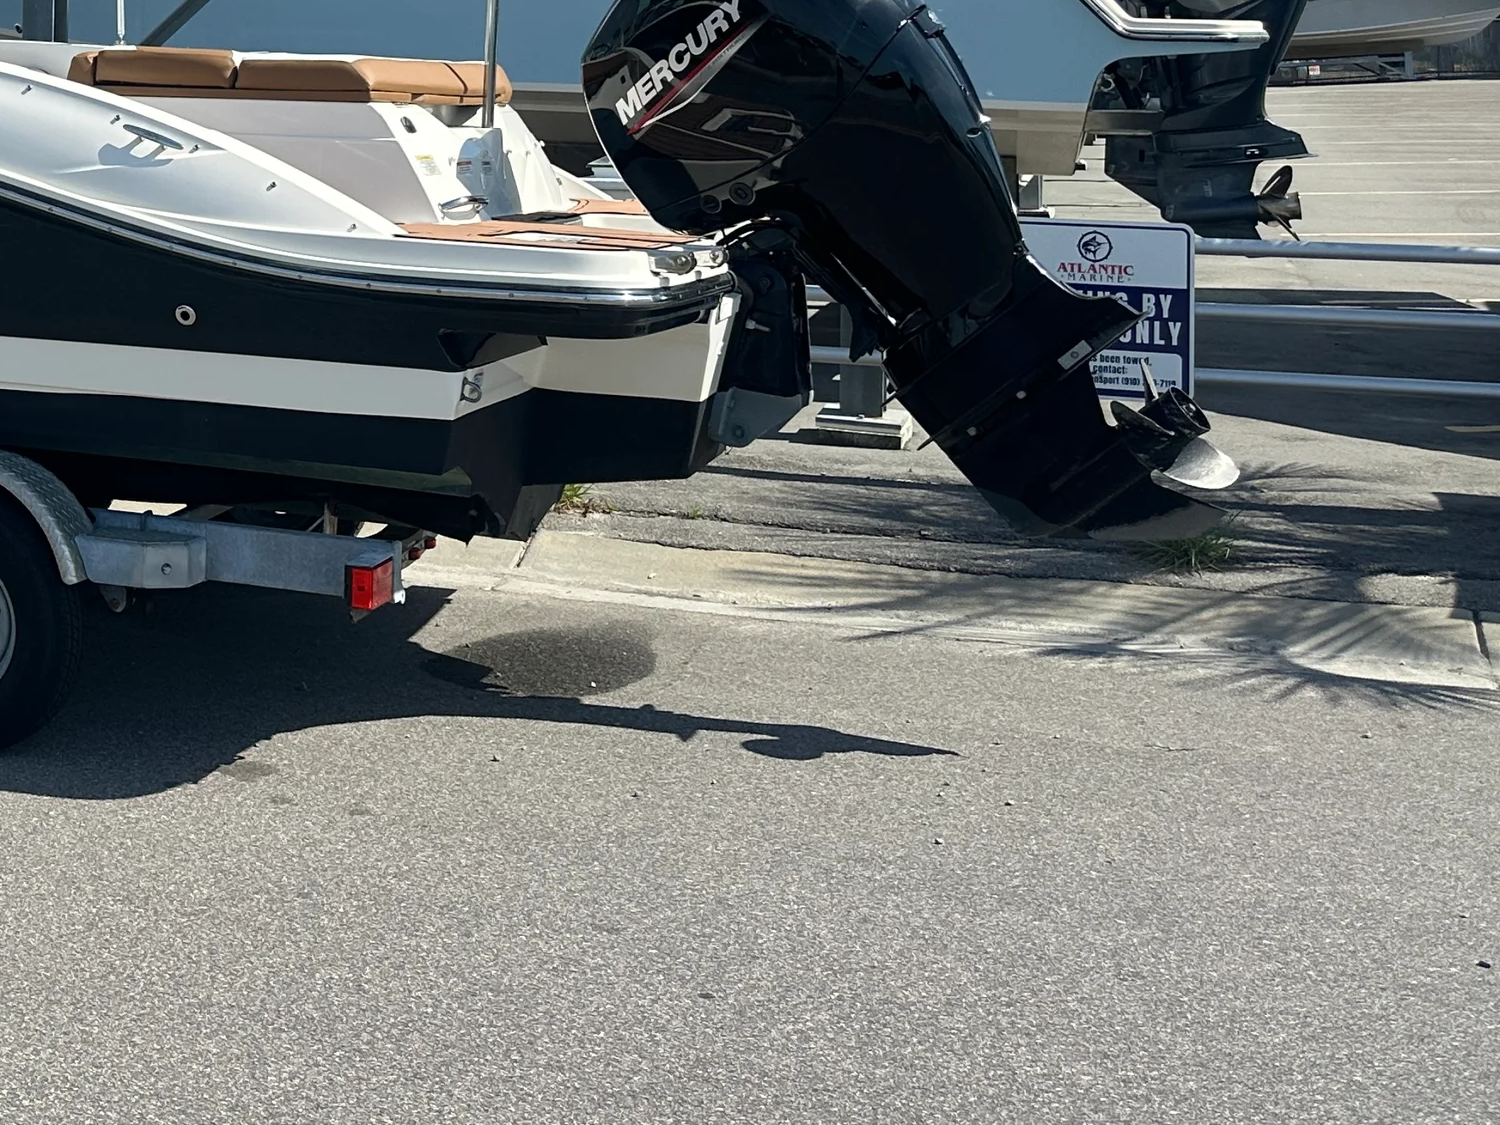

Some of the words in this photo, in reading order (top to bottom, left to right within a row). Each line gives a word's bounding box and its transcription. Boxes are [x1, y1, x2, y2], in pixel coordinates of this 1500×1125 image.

[1057, 261, 1135, 276] ATLANTIC
[1067, 273, 1125, 284] MARINE
[1142, 293, 1173, 318] BY
[1100, 354, 1121, 364] been
